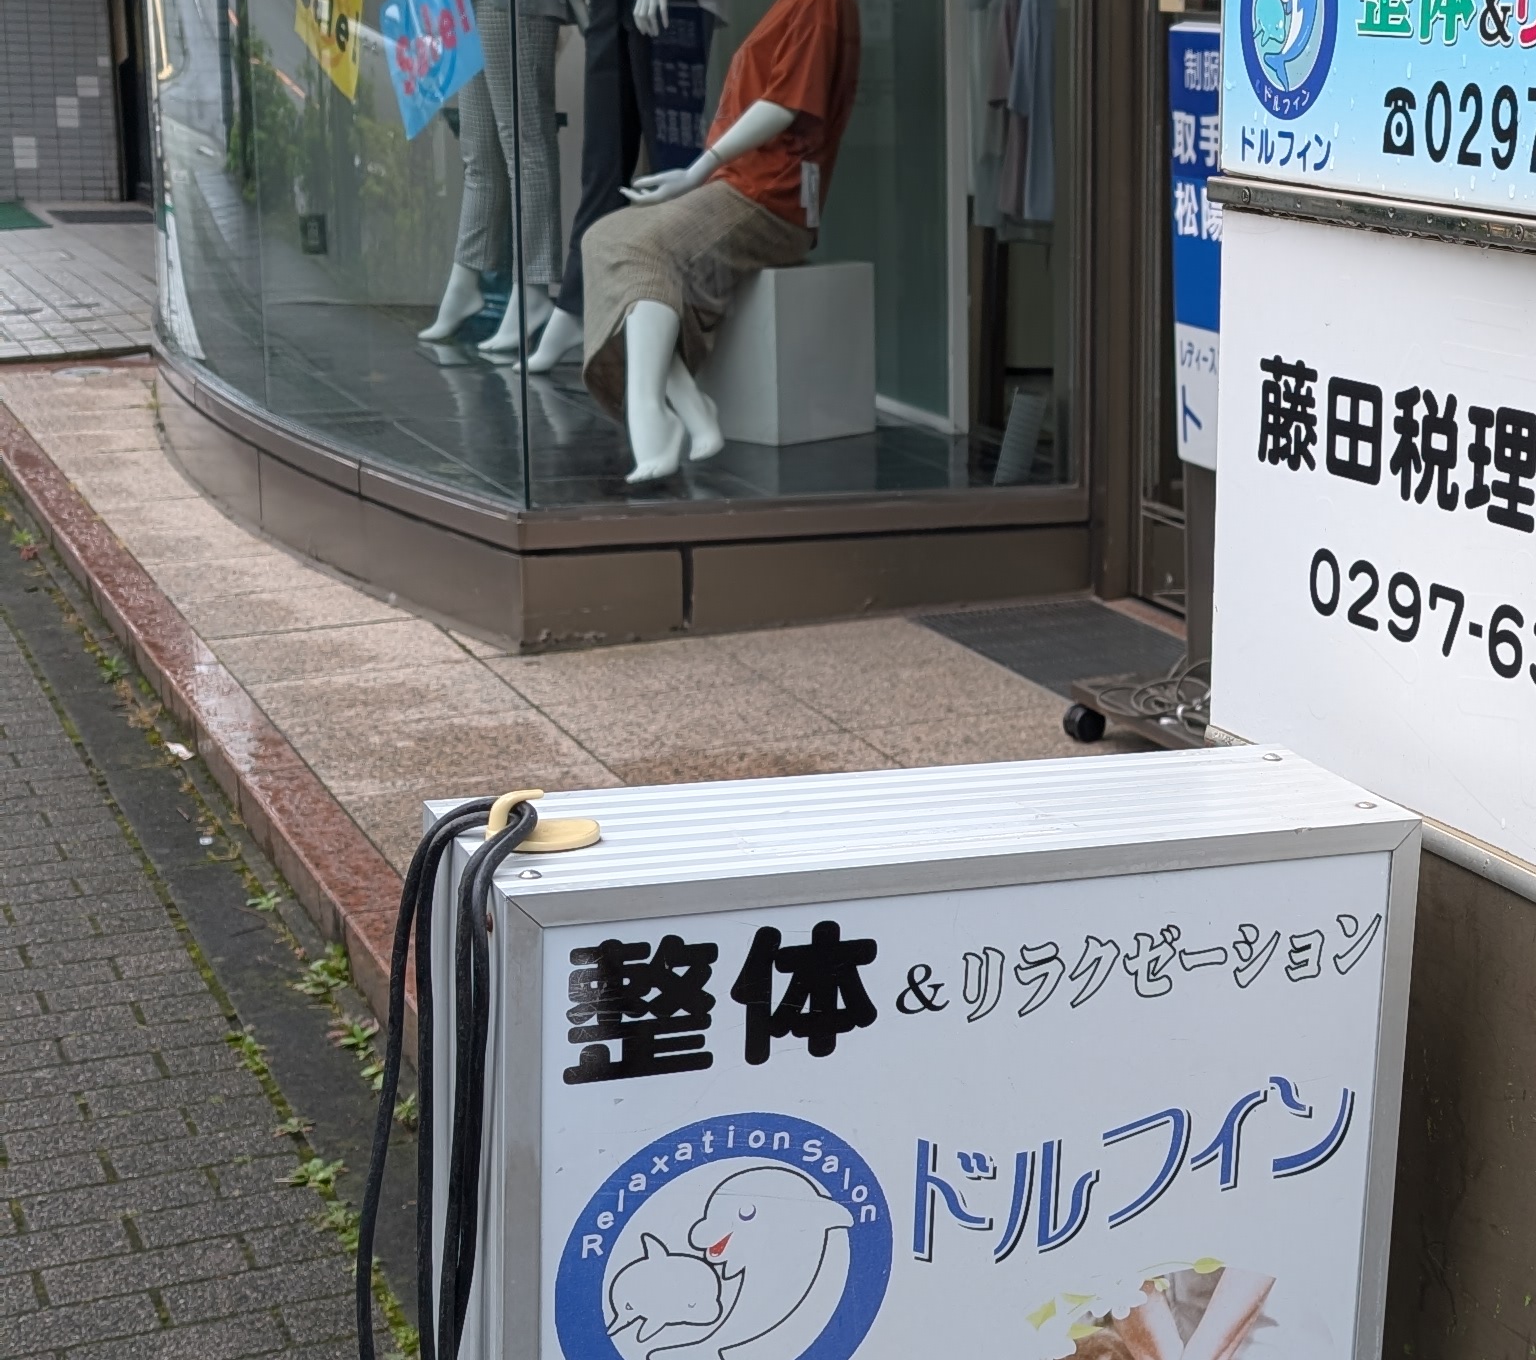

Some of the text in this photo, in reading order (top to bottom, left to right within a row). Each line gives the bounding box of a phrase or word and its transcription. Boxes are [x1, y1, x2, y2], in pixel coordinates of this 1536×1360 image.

[1264, 87, 1310, 112] ドルフィン
[1241, 125, 1332, 172] ドルフィン
[581, 1125, 876, 1259] Relaxation Salon
[912, 1075, 1356, 1263] ドルフィン
